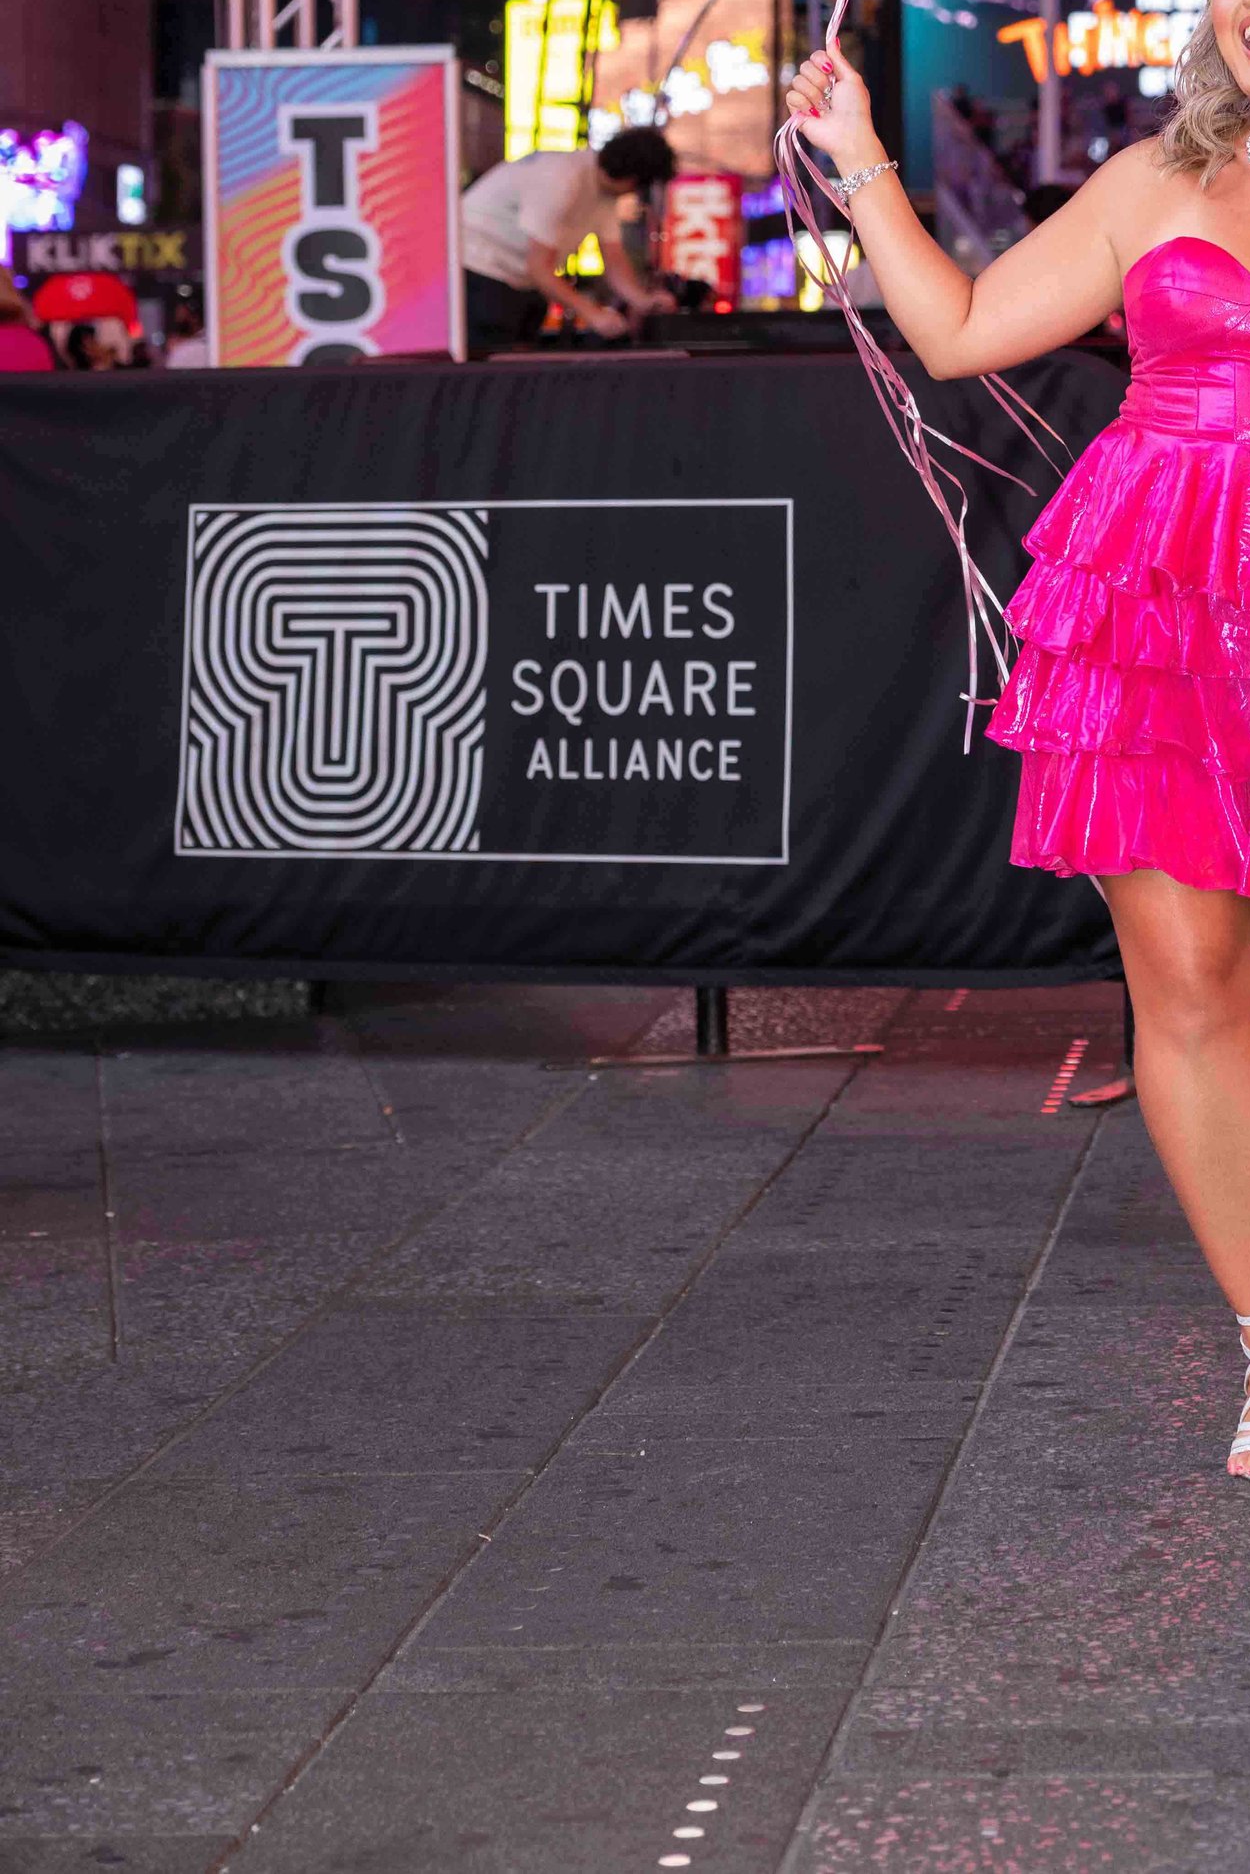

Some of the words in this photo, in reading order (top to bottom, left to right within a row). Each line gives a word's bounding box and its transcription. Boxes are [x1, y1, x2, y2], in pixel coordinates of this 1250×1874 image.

[534, 582, 735, 639] TIMES
[511, 660, 756, 726] SQUARE
[526, 738, 742, 781] ALLIANCE
